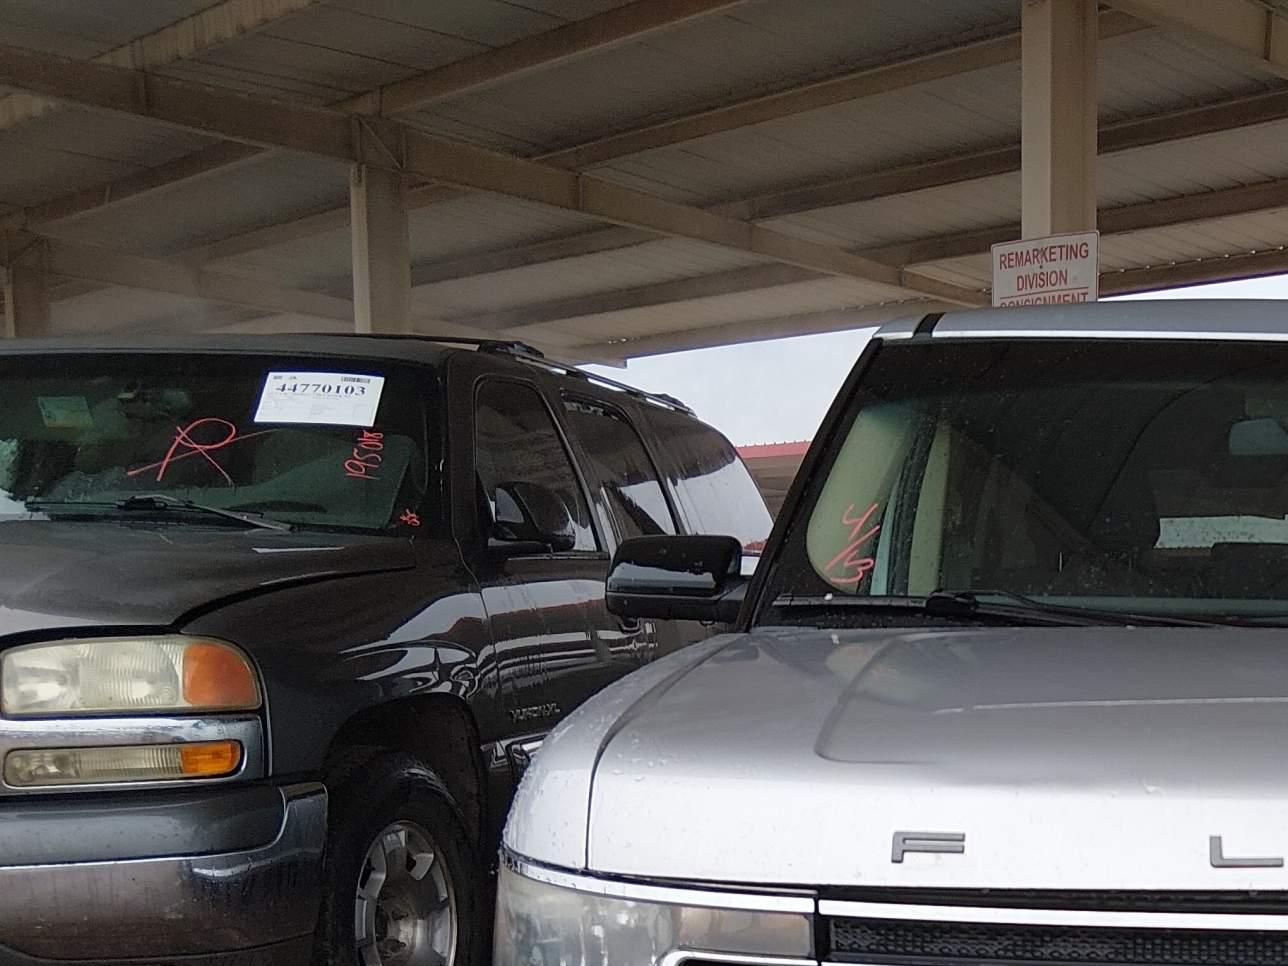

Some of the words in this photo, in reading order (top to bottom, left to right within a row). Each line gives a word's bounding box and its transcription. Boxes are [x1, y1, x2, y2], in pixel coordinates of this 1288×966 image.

[999, 242, 1089, 269] REMARKETING
[1016, 269, 1068, 292] DIVISION
[275, 383, 366, 396] 44770103
